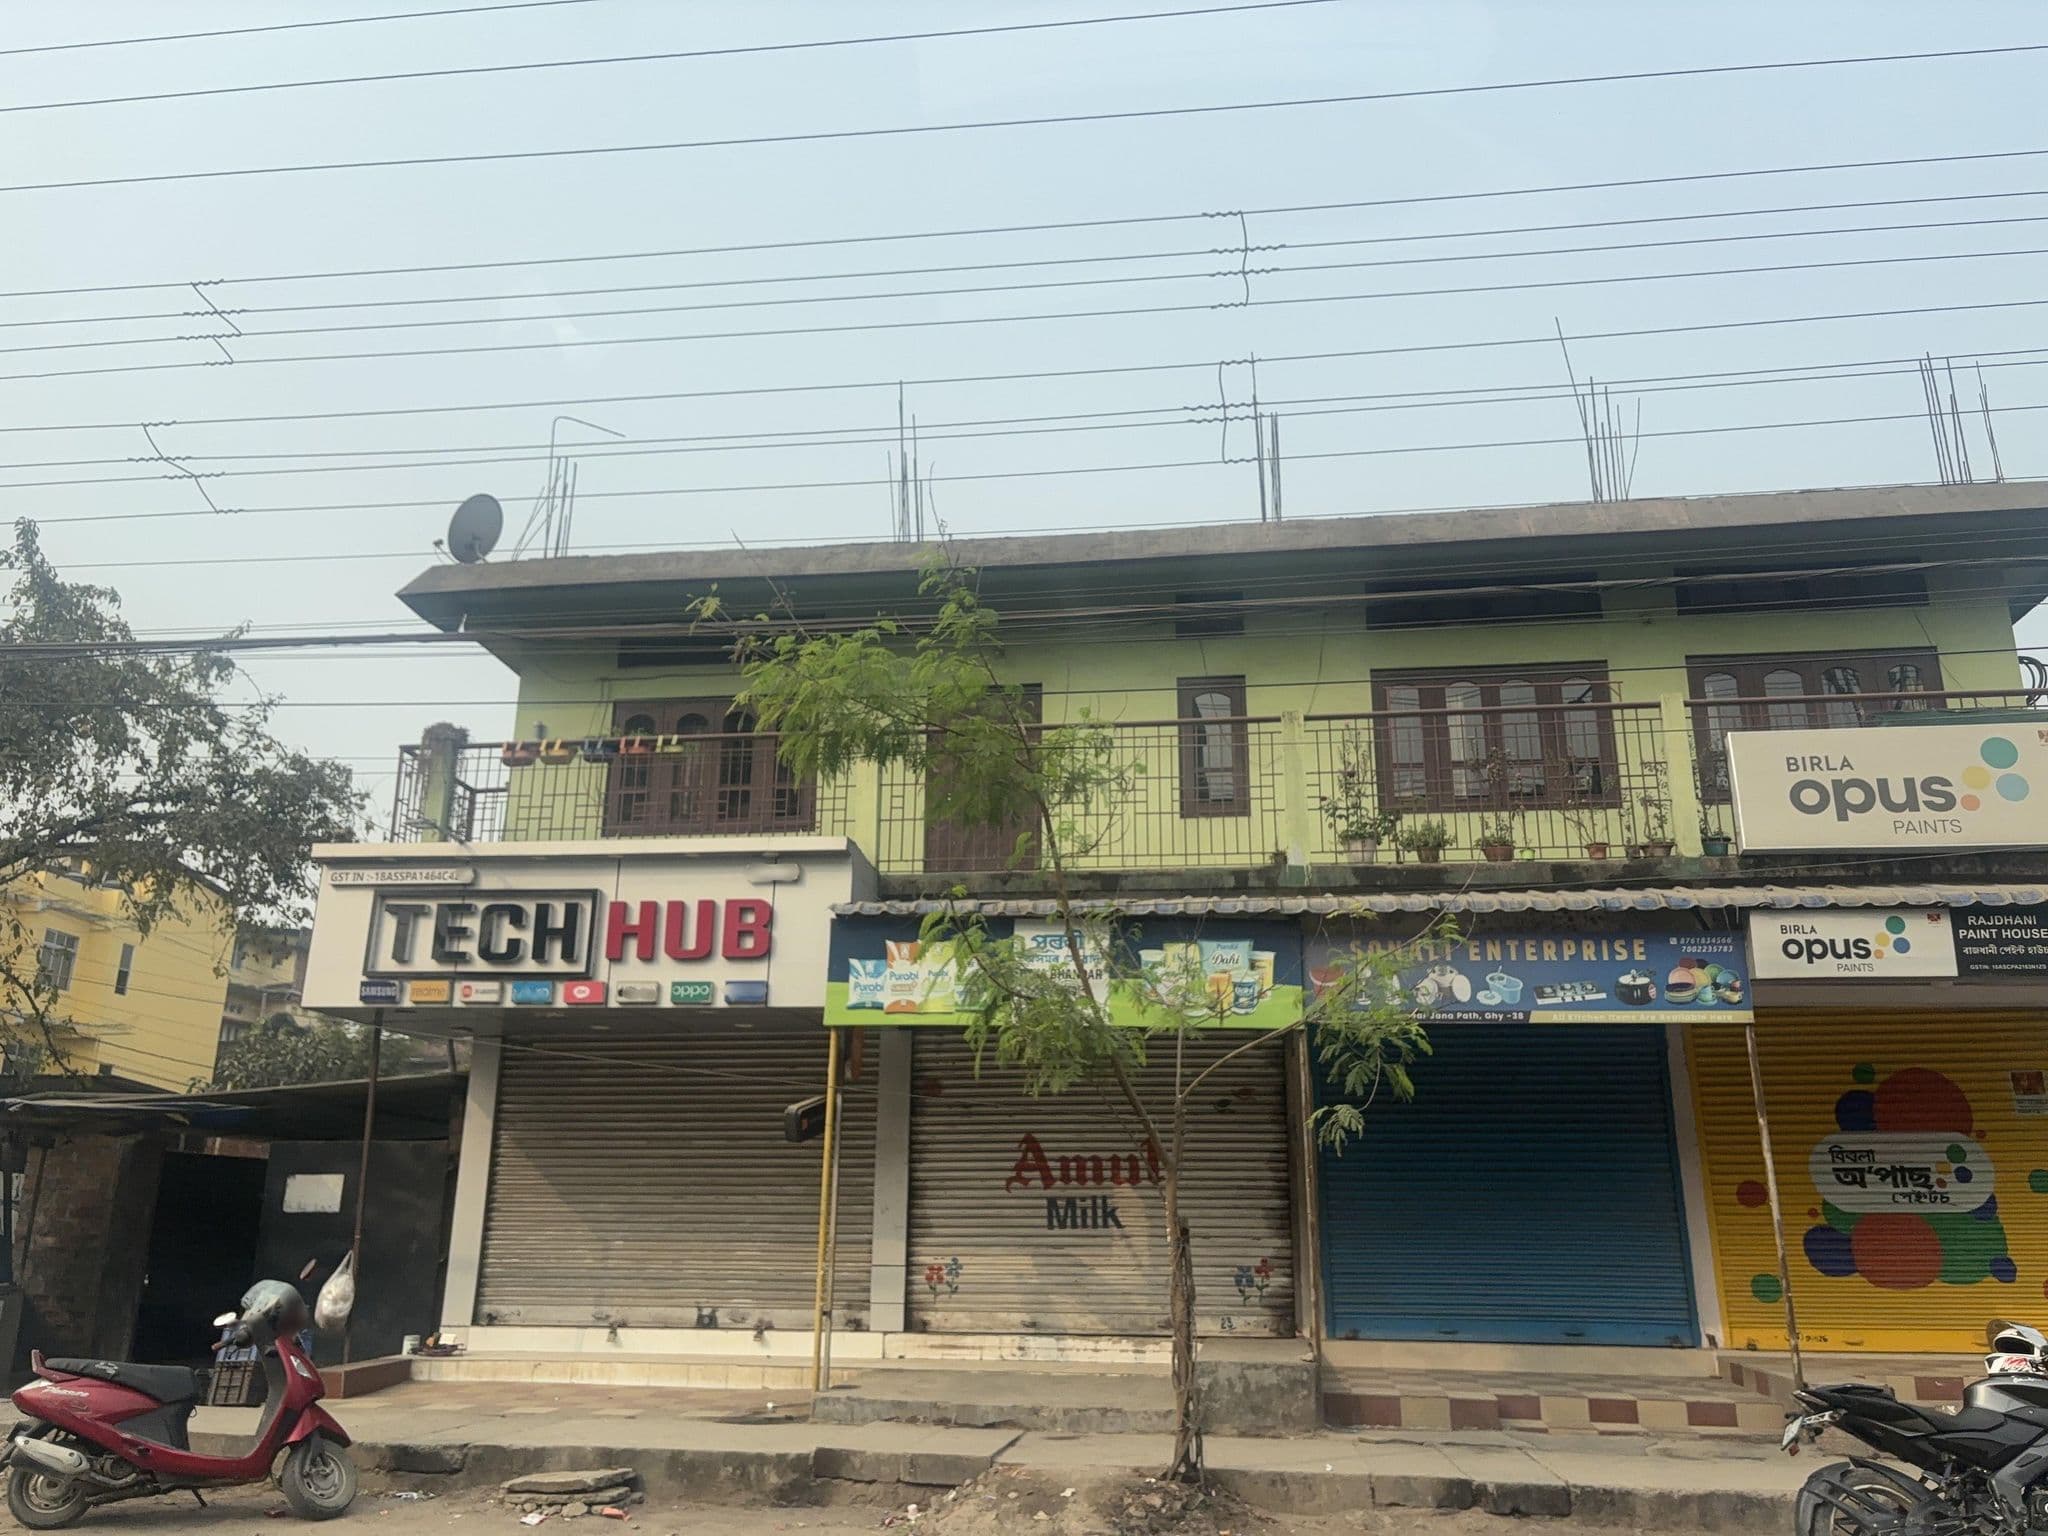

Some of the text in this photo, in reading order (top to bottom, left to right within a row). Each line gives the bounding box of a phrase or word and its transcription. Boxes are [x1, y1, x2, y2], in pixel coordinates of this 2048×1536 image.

[1785, 755, 1855, 772] BIRLA
[1789, 775, 1958, 822] opus
[1893, 819, 1962, 835] PAINTS
[330, 871, 349, 882] GST
[1967, 915, 2037, 926] RAJDHANI
[384, 898, 773, 962] TECH HUB
[1780, 924, 1817, 935] BIRLA
[1959, 928, 2048, 939] PAINT HOUSE
[1468, 938, 1647, 961] ENTERPRISE
[1782, 936, 1872, 964] opus
[1211, 951, 1241, 965] Dahi
[1837, 963, 1874, 972] PAINTS
[361, 986, 398, 997] SAMSUNG
[671, 985, 709, 998] oppo
[1430, 1012, 1454, 1020] Jana
[1456, 1011, 1482, 1021] Path,
[1486, 1011, 1504, 1022] Ghy
[1004, 1133, 1166, 1193] Amul
[1045, 1195, 1126, 1231] Milk
